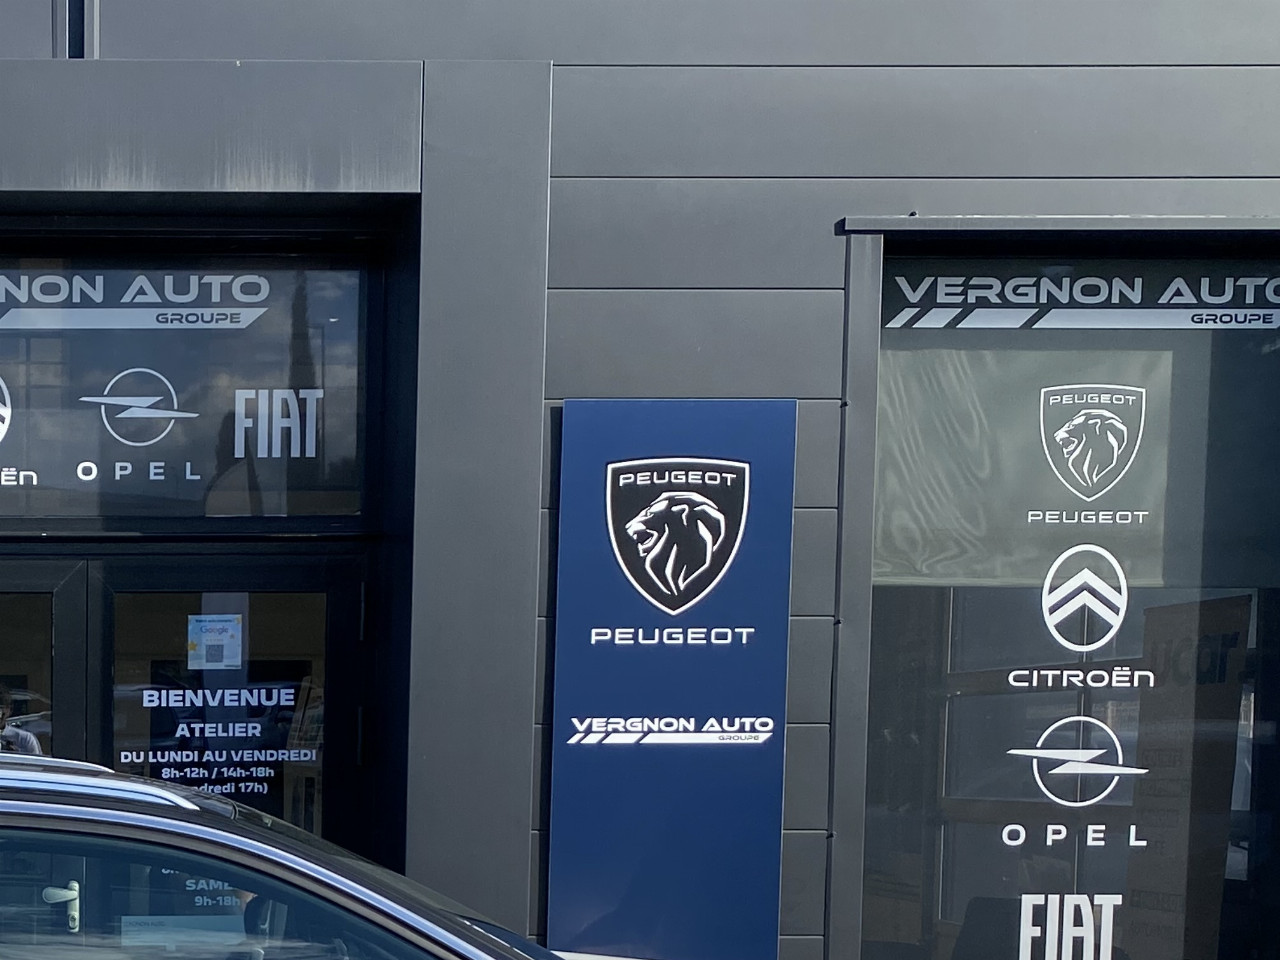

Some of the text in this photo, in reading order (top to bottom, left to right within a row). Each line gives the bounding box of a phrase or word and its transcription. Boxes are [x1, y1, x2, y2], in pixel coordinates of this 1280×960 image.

[119, 275, 270, 304] AUTO
[894, 276, 1143, 304] VERGNON
[155, 311, 242, 325] GROUPE
[1190, 313, 1274, 324] GROUPE
[1048, 393, 1137, 406] PEUGEOT
[234, 388, 324, 459] FIAT
[76, 461, 202, 482] OPEL
[618, 470, 737, 487] PEUGEOT
[1027, 510, 1150, 525] PEUGEOT
[590, 627, 756, 645] PEUGEOT
[142, 688, 295, 708] BIENVENUE
[174, 722, 262, 738] ATELIER
[571, 717, 774, 732] VERGNON AUTO
[120, 749, 317, 763] DU LUNDI AU VENDREDI
[161, 767, 209, 779] 8h-12h
[220, 766, 275, 778] 14h-18h
[195, 782, 269, 794] dredi 17h)
[1001, 823, 1148, 847] OPEL
[194, 895, 240, 906] 9h-18h
